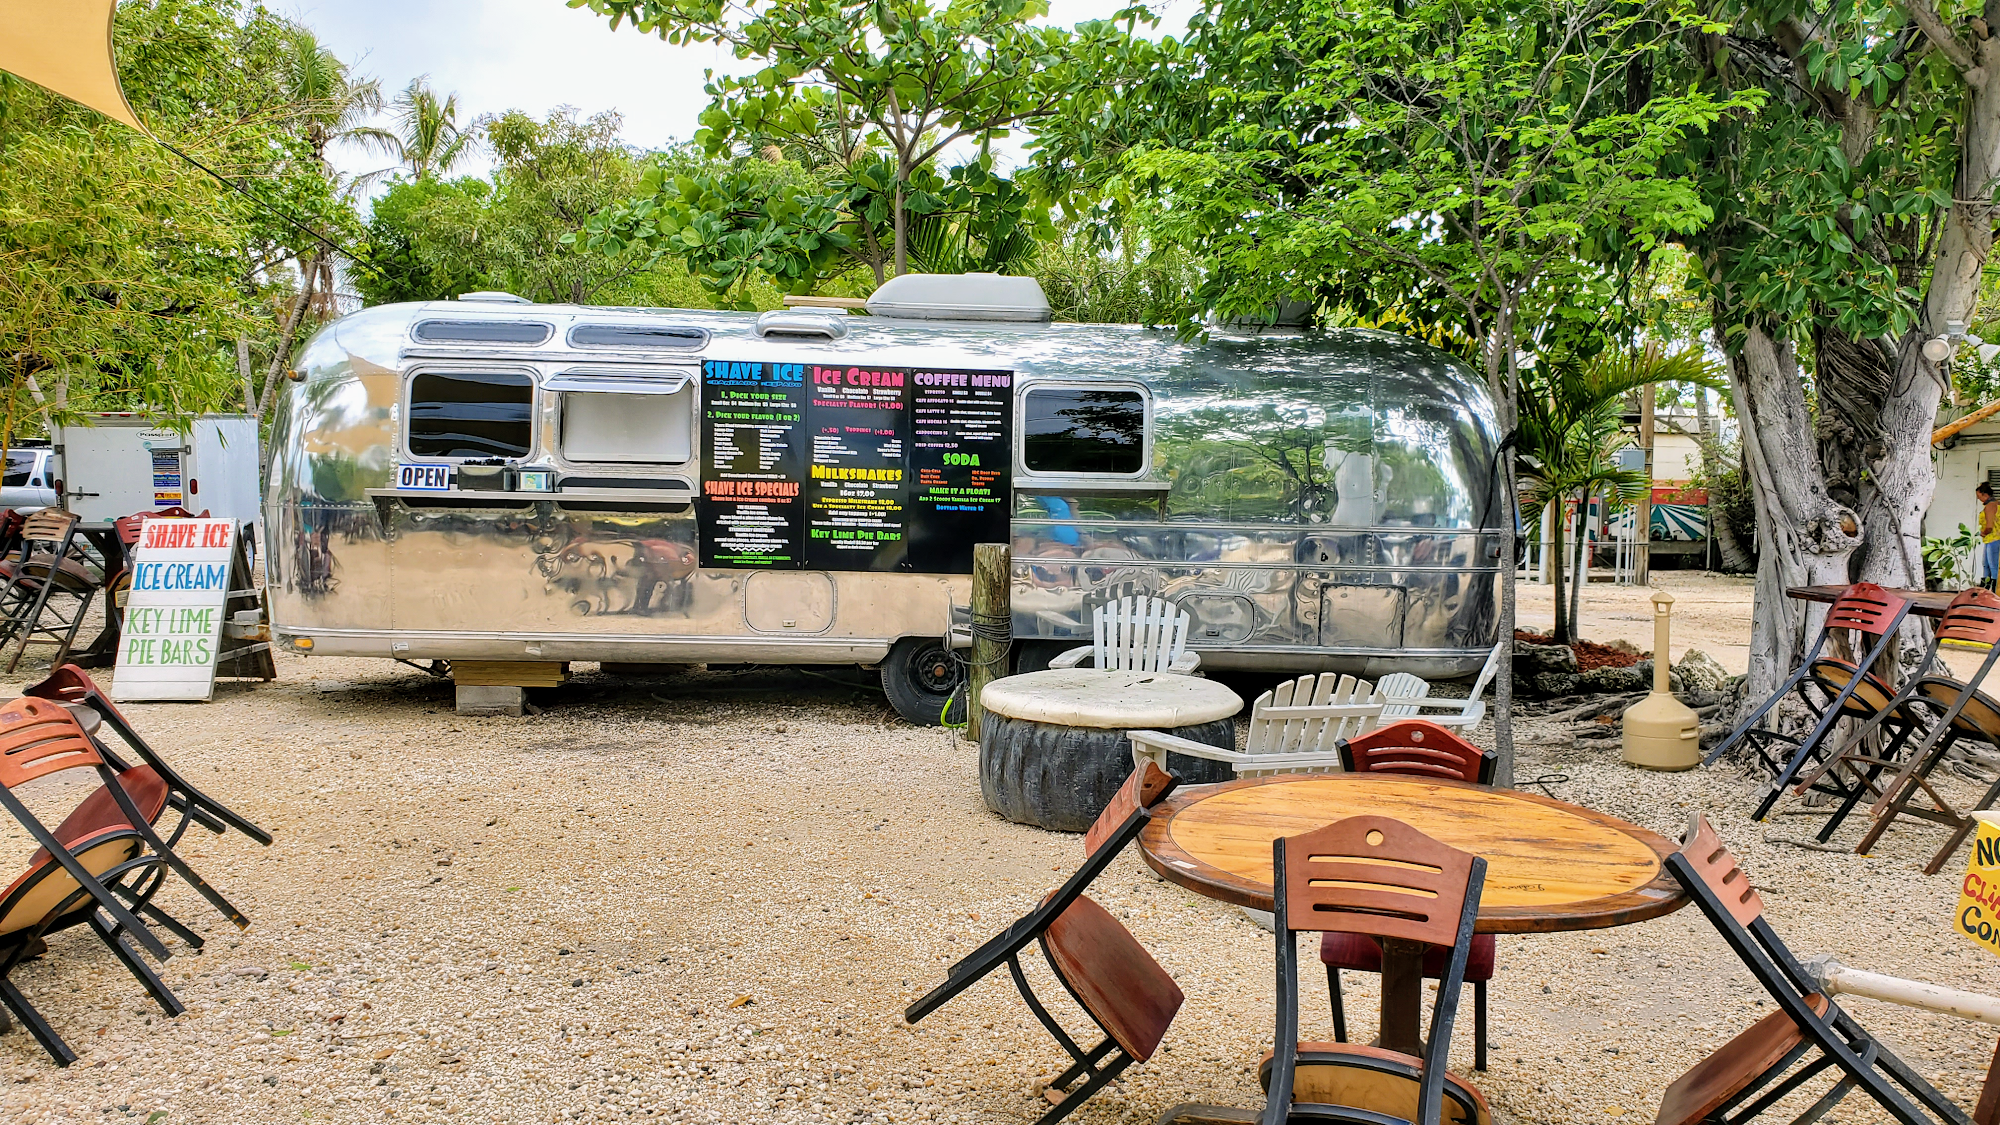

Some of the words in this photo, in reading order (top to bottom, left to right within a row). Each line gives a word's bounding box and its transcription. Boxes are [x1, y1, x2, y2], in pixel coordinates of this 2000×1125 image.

[704, 361, 762, 380] SHAVE
[773, 364, 804, 381] ICE
[813, 366, 841, 384] ICE
[847, 368, 904, 387] CREAM
[914, 373, 968, 386] COFFEE
[721, 391, 728, 399] 1.
[730, 391, 748, 399] PICK
[943, 453, 980, 466] SODA
[402, 467, 446, 486] OPEN
[811, 465, 902, 480] MILKSHAKES
[705, 481, 735, 495] SHAVE
[737, 481, 753, 495] ICE
[755, 482, 799, 496] SPECIALS
[145, 523, 197, 549] SHAVE
[202, 524, 230, 548] ICE
[811, 529, 830, 538] KEY
[833, 530, 854, 539] LIME
[857, 530, 874, 539] PIE
[877, 531, 901, 540] BARS
[133, 563, 162, 590] ICE
[163, 563, 225, 590] CREAM
[127, 607, 164, 634] KEY
[169, 608, 214, 634] LIME
[127, 639, 156, 665] PIE
[161, 638, 211, 665] BARS
